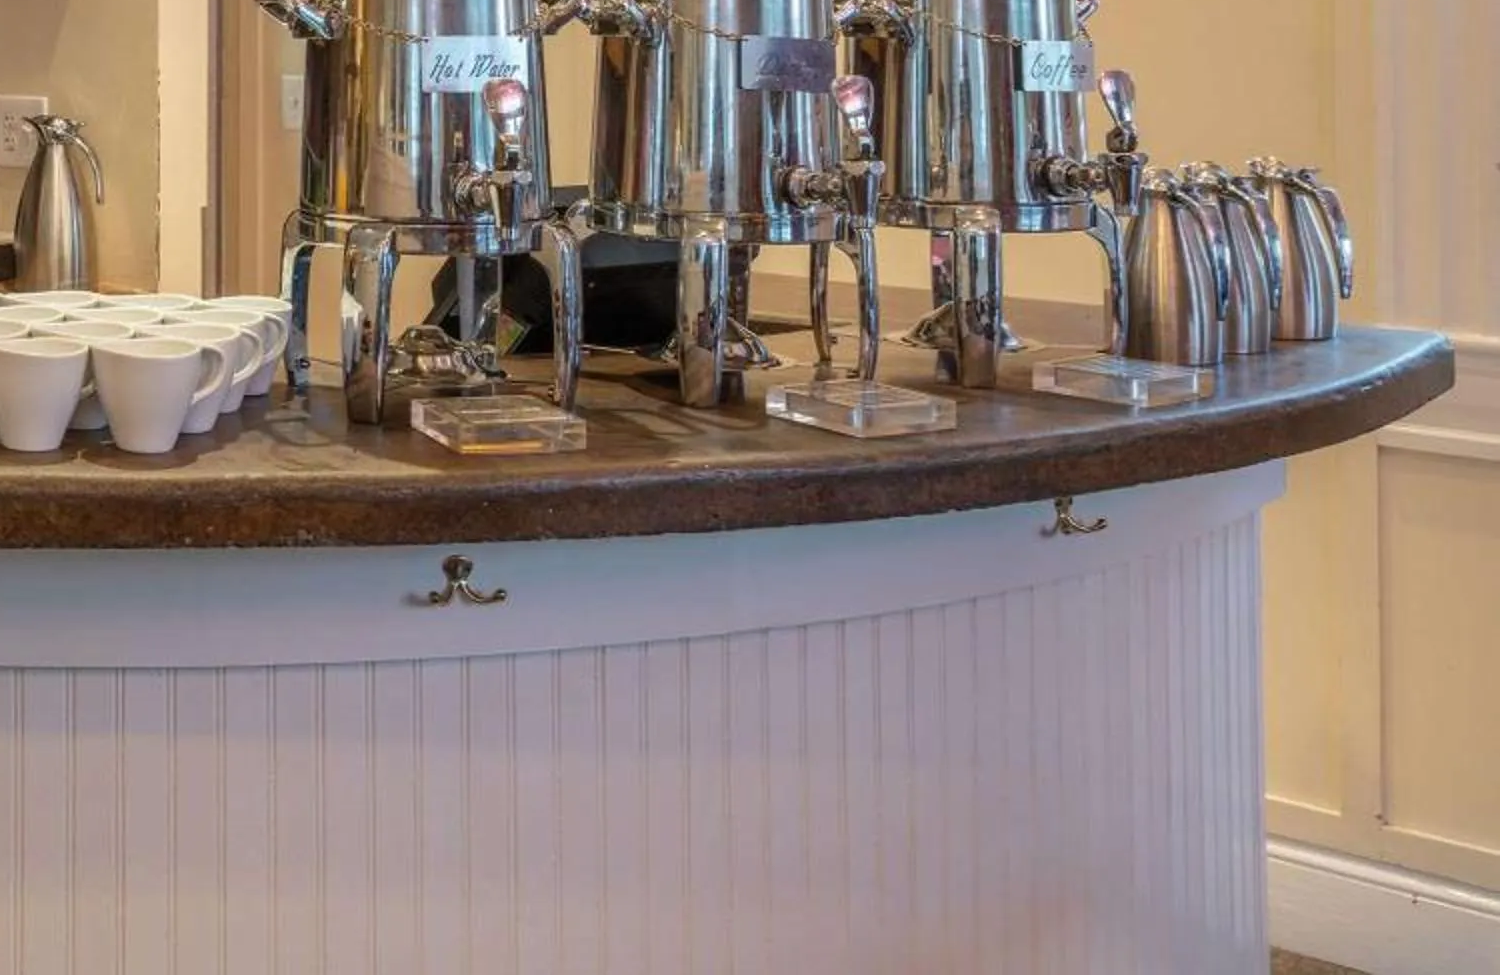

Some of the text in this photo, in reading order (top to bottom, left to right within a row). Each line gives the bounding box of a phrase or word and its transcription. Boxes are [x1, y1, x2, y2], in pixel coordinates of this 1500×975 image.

[429, 54, 521, 83] Hot Water
[1031, 52, 1088, 86] Coffee
